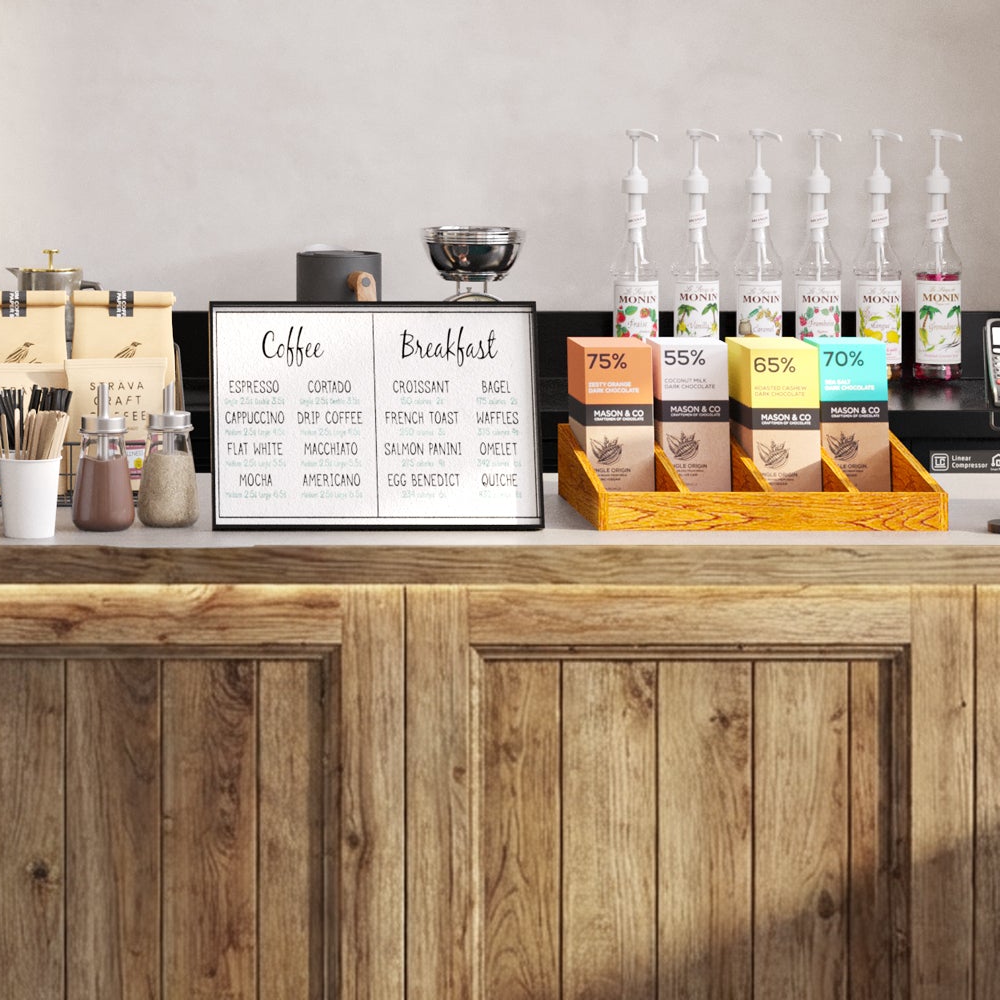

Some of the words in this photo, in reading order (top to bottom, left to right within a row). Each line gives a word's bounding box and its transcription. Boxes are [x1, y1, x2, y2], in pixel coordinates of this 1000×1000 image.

[619, 296, 656, 304] MONIN
[679, 293, 718, 301] MONIN
[743, 295, 779, 303] MONIN
[802, 295, 839, 304] MONIN
[863, 295, 900, 304] MONIN
[922, 293, 959, 302] MONIN
[262, 326, 325, 367] Coffee
[400, 326, 499, 367] Breakfast
[587, 353, 627, 369] 75%
[664, 349, 706, 366] 55%
[823, 351, 864, 367] 70%
[754, 357, 796, 373] 65%
[90, 381, 144, 391] SRAVA
[229, 380, 280, 394] ESPRESSO
[308, 380, 352, 394] CORTADO
[392, 380, 450, 394] CROISSANT
[481, 380, 511, 394] BAGEL
[593, 409, 623, 418] MASON
[624, 409, 631, 418] &
[632, 409, 645, 418] CO
[670, 405, 700, 413] MASON
[701, 405, 707, 413] &
[709, 405, 721, 413] CO
[830, 406, 860, 414] MASON
[861, 406, 867, 414] &
[868, 406, 880, 414] CO
[225, 411, 285, 425] CAPPUCCINO
[297, 411, 320, 425] DRIP
[325, 411, 363, 425] COFFEE
[385, 411, 424, 425] FRENCH
[429, 411, 459, 425] TOAST
[476, 411, 519, 425] WAFFLES
[761, 413, 790, 421] MASON
[792, 413, 798, 421] &
[799, 413, 812, 421] CO
[227, 442, 248, 456] FLAT
[253, 442, 283, 456] WHITE
[304, 442, 358, 456] MACCHIATO
[384, 442, 424, 456] SALMON
[429, 442, 462, 456] PANINI
[479, 442, 518, 456] OMELET
[239, 473, 273, 487] MOCHA
[302, 473, 361, 487] AMERICANO
[387, 473, 407, 487] EGG
[411, 473, 460, 487] BENEDICT
[481, 473, 518, 487] QUICHE
